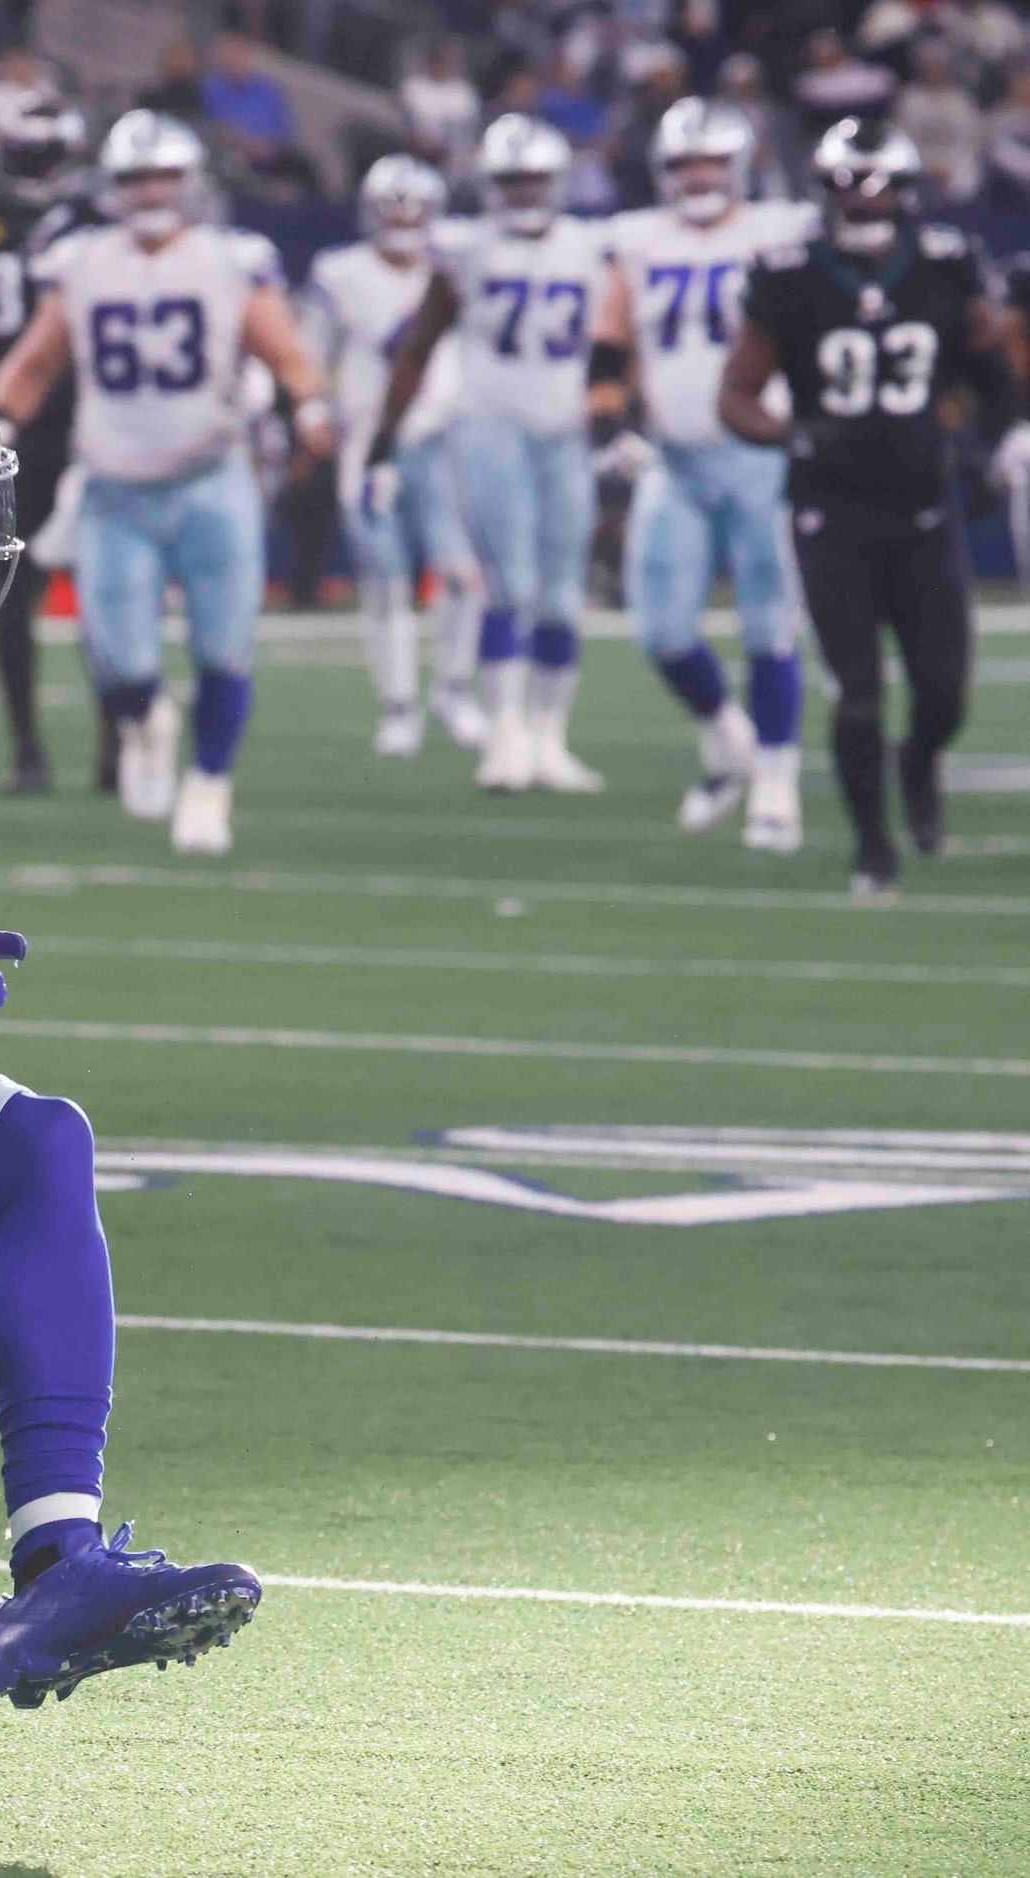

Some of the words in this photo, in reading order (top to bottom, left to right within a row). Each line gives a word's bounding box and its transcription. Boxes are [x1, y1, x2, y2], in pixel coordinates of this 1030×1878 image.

[91, 297, 205, 391] 63
[484, 279, 587, 357] 73
[818, 323, 938, 415] 93
